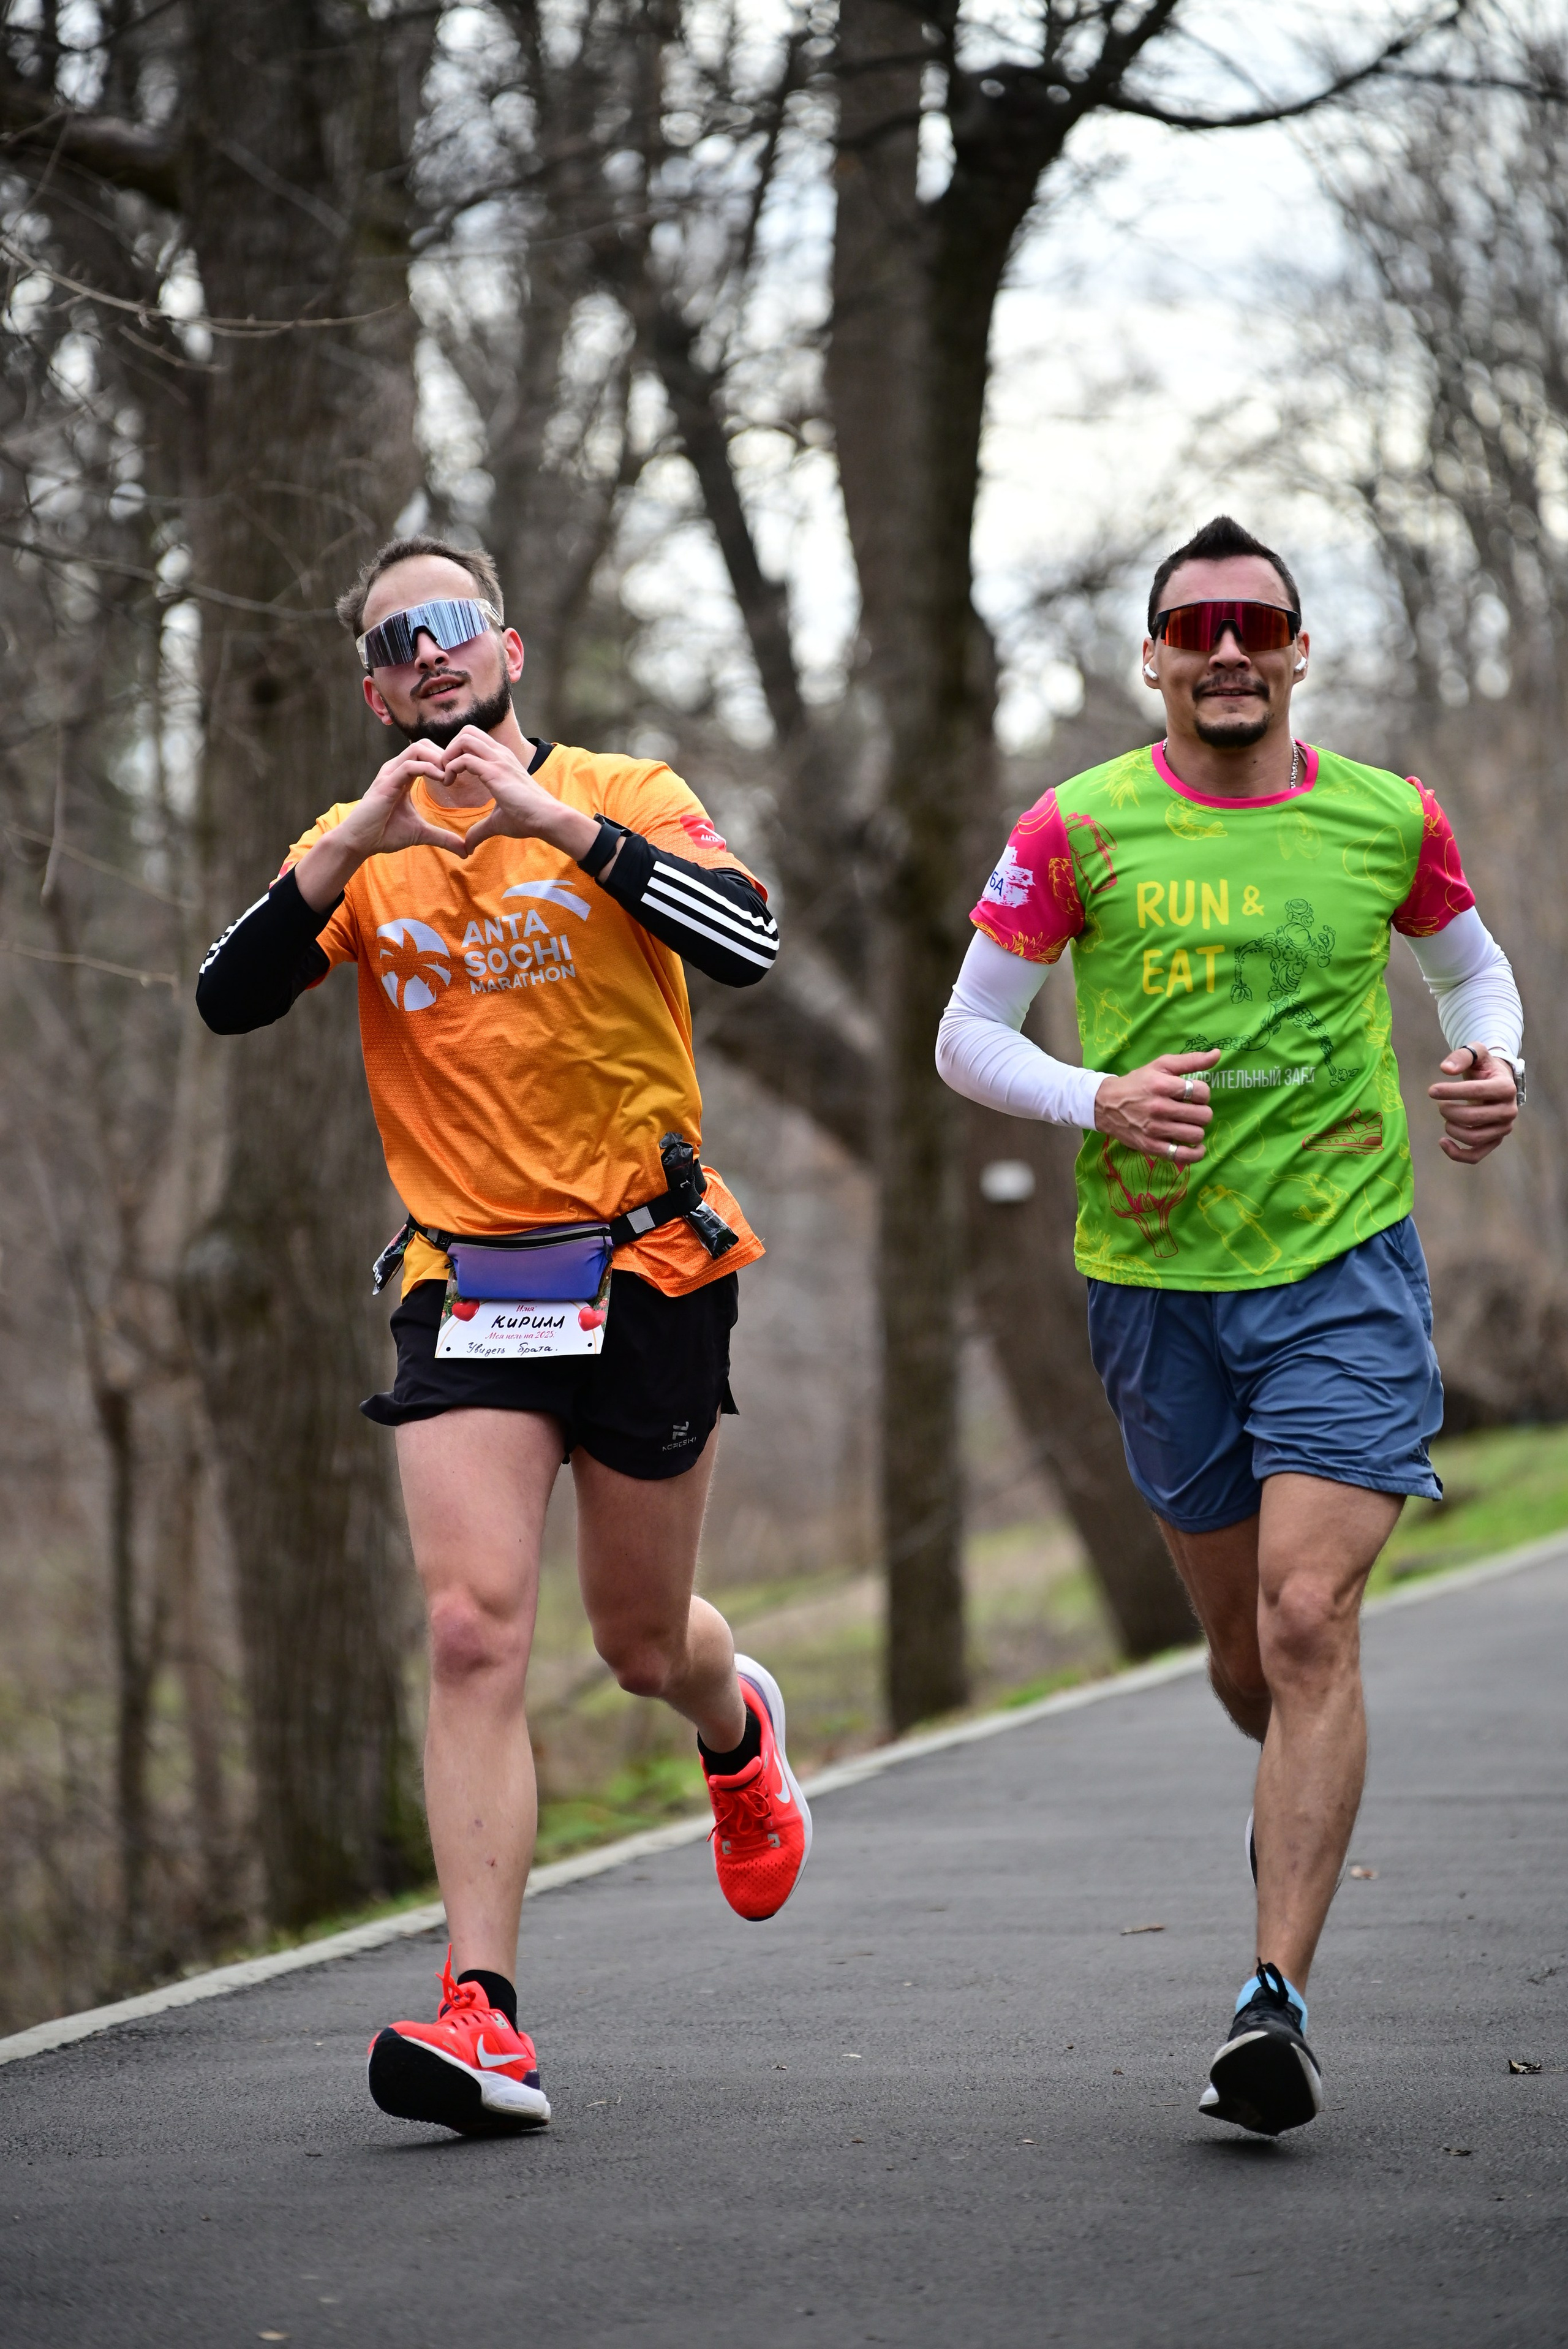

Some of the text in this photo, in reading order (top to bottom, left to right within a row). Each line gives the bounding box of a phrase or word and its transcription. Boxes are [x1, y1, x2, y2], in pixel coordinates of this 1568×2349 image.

[1137, 879, 1265, 930] RUN &
[461, 909, 550, 948] ANTA
[464, 934, 573, 977] SOCHI
[1142, 945, 1226, 998] EAT
[470, 964, 576, 994] MARATHON
[466, 1342, 505, 1357] Увидеть
